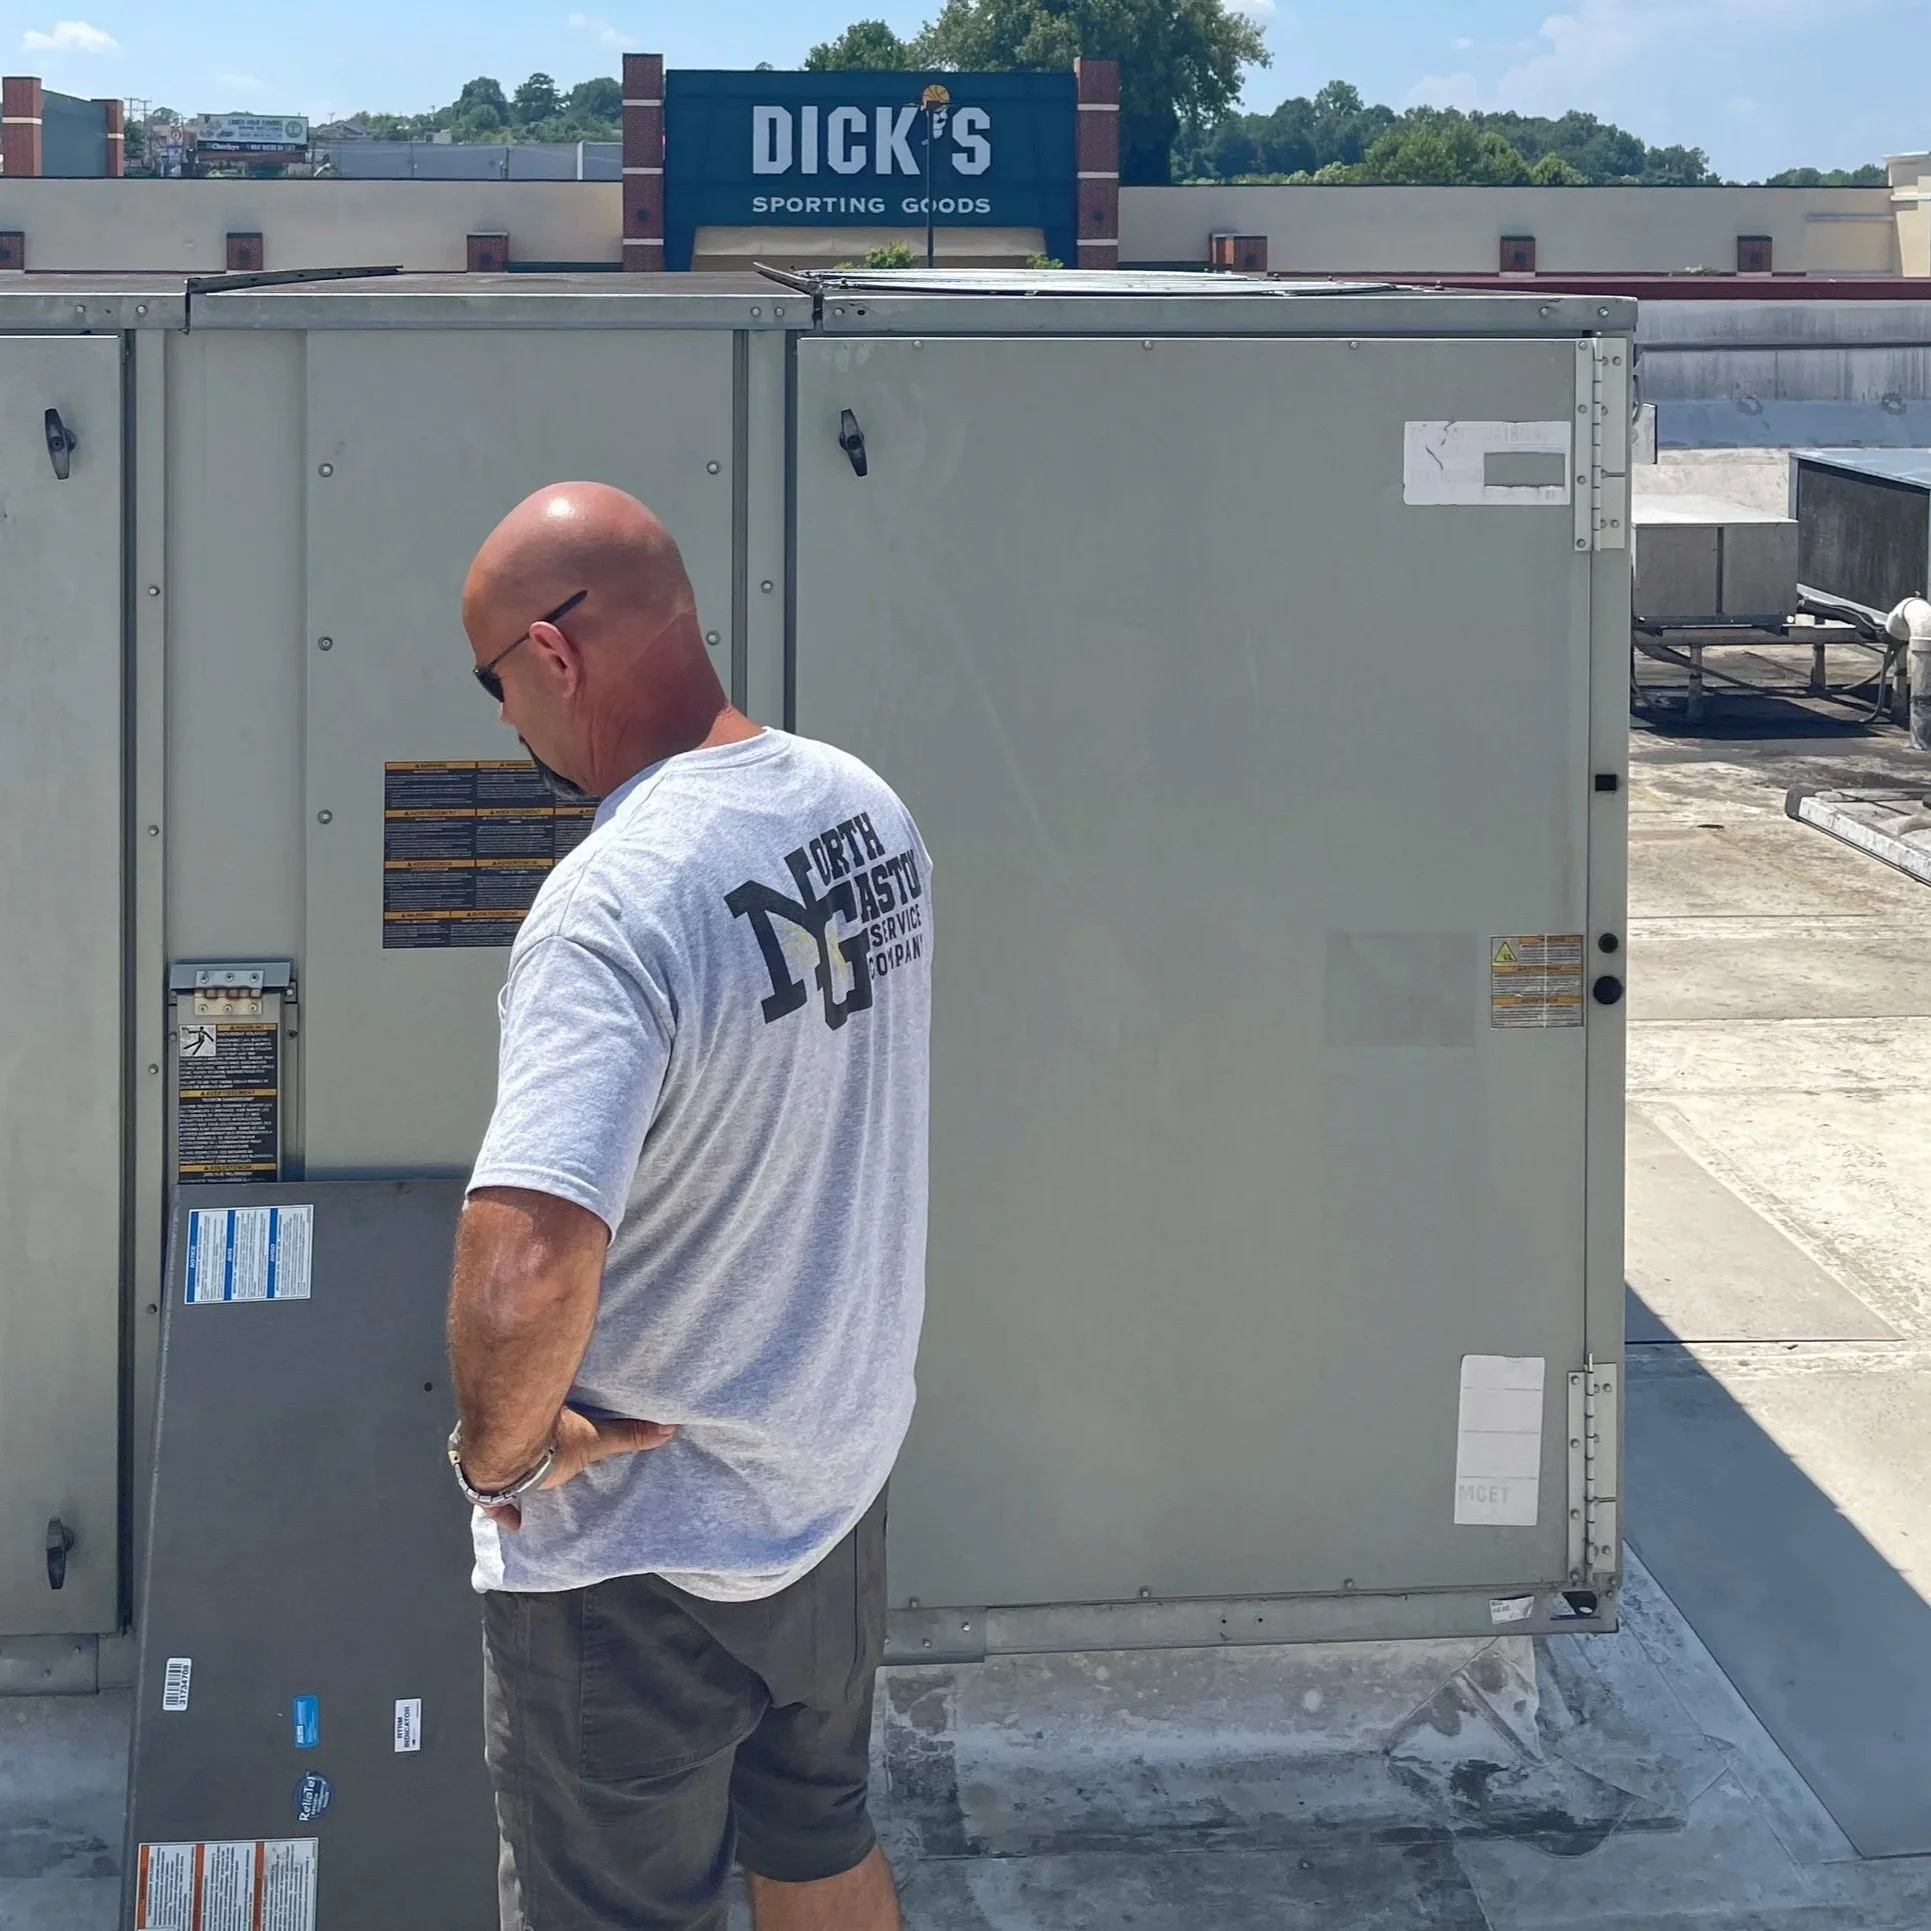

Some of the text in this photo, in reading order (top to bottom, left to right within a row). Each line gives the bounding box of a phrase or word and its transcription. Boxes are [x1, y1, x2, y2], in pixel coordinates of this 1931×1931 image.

[753, 104, 991, 175] DICK'S
[752, 196, 991, 213] SPORTING GOODS
[869, 903, 922, 948] SERVICE
